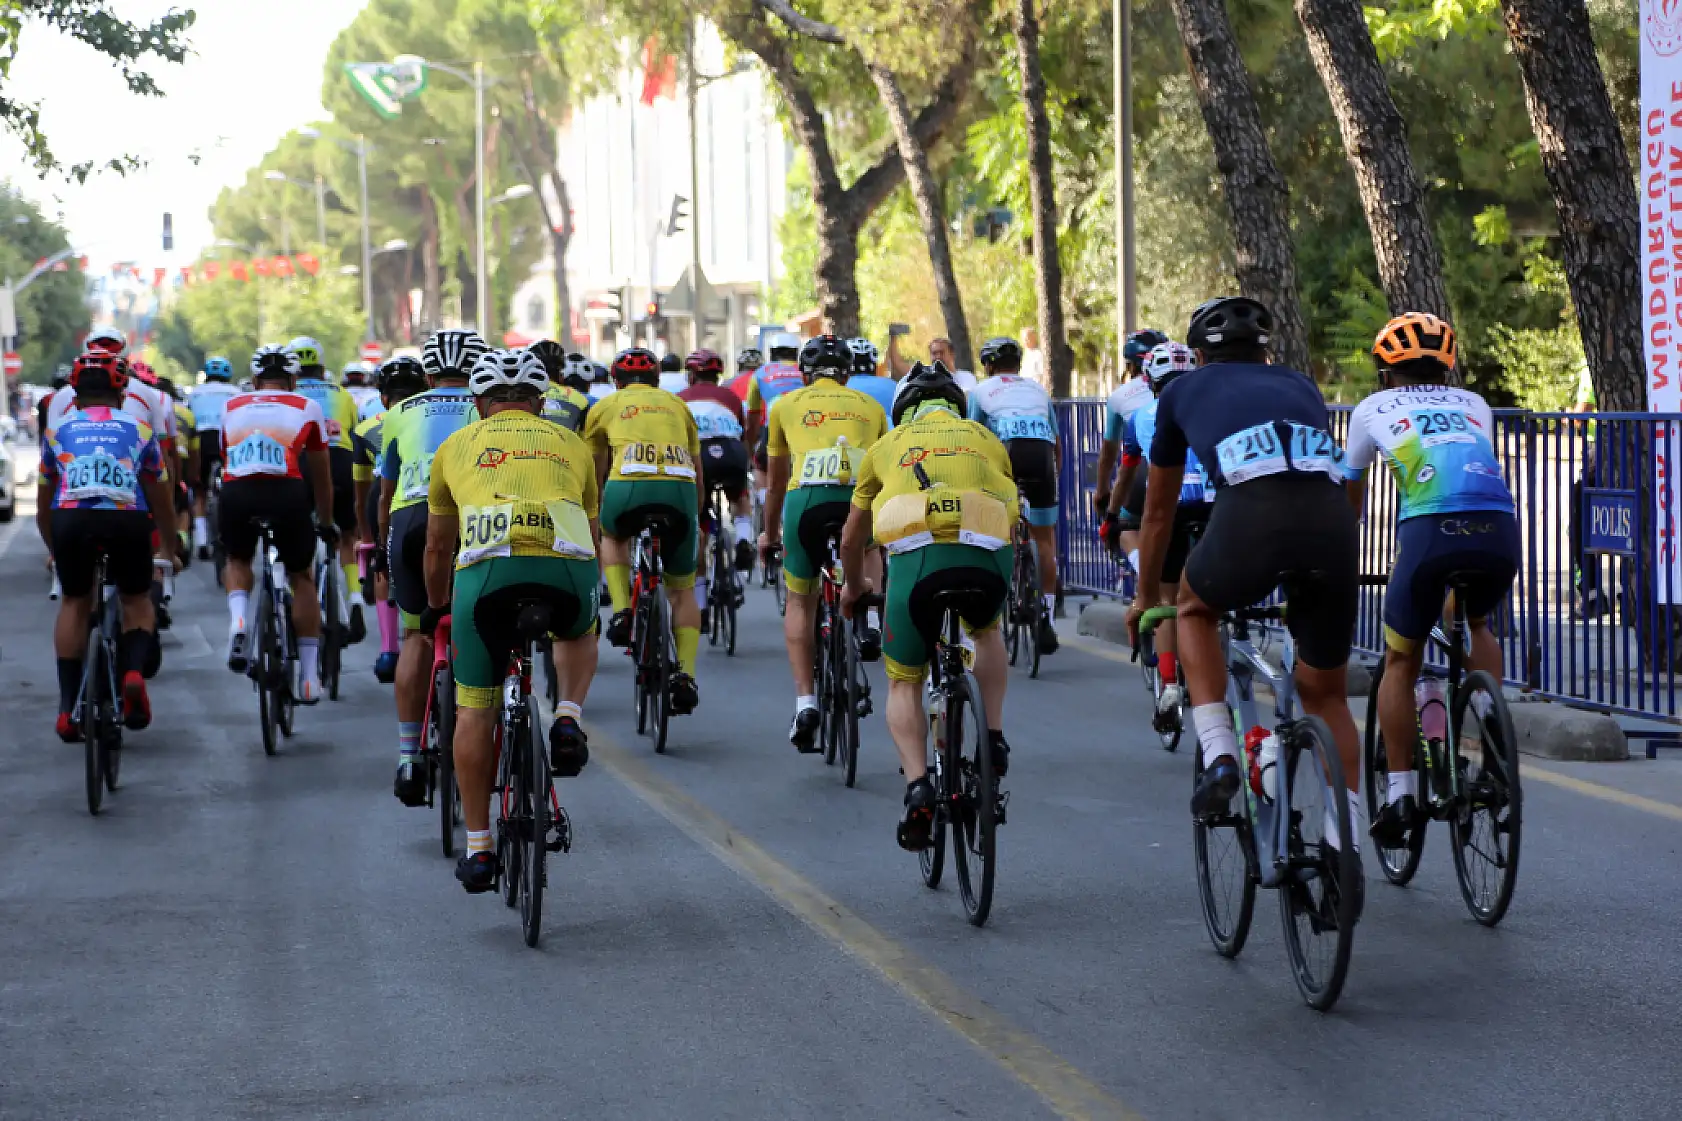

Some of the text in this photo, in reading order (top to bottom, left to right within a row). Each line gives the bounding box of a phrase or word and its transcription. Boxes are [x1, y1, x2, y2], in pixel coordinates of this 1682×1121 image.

[1416, 412, 1467, 436] 299
[257, 440, 284, 465] 110
[803, 453, 838, 478] 510
[94, 459, 124, 488] 126
[465, 512, 508, 547] 509
[1591, 504, 1631, 538] POLİS
